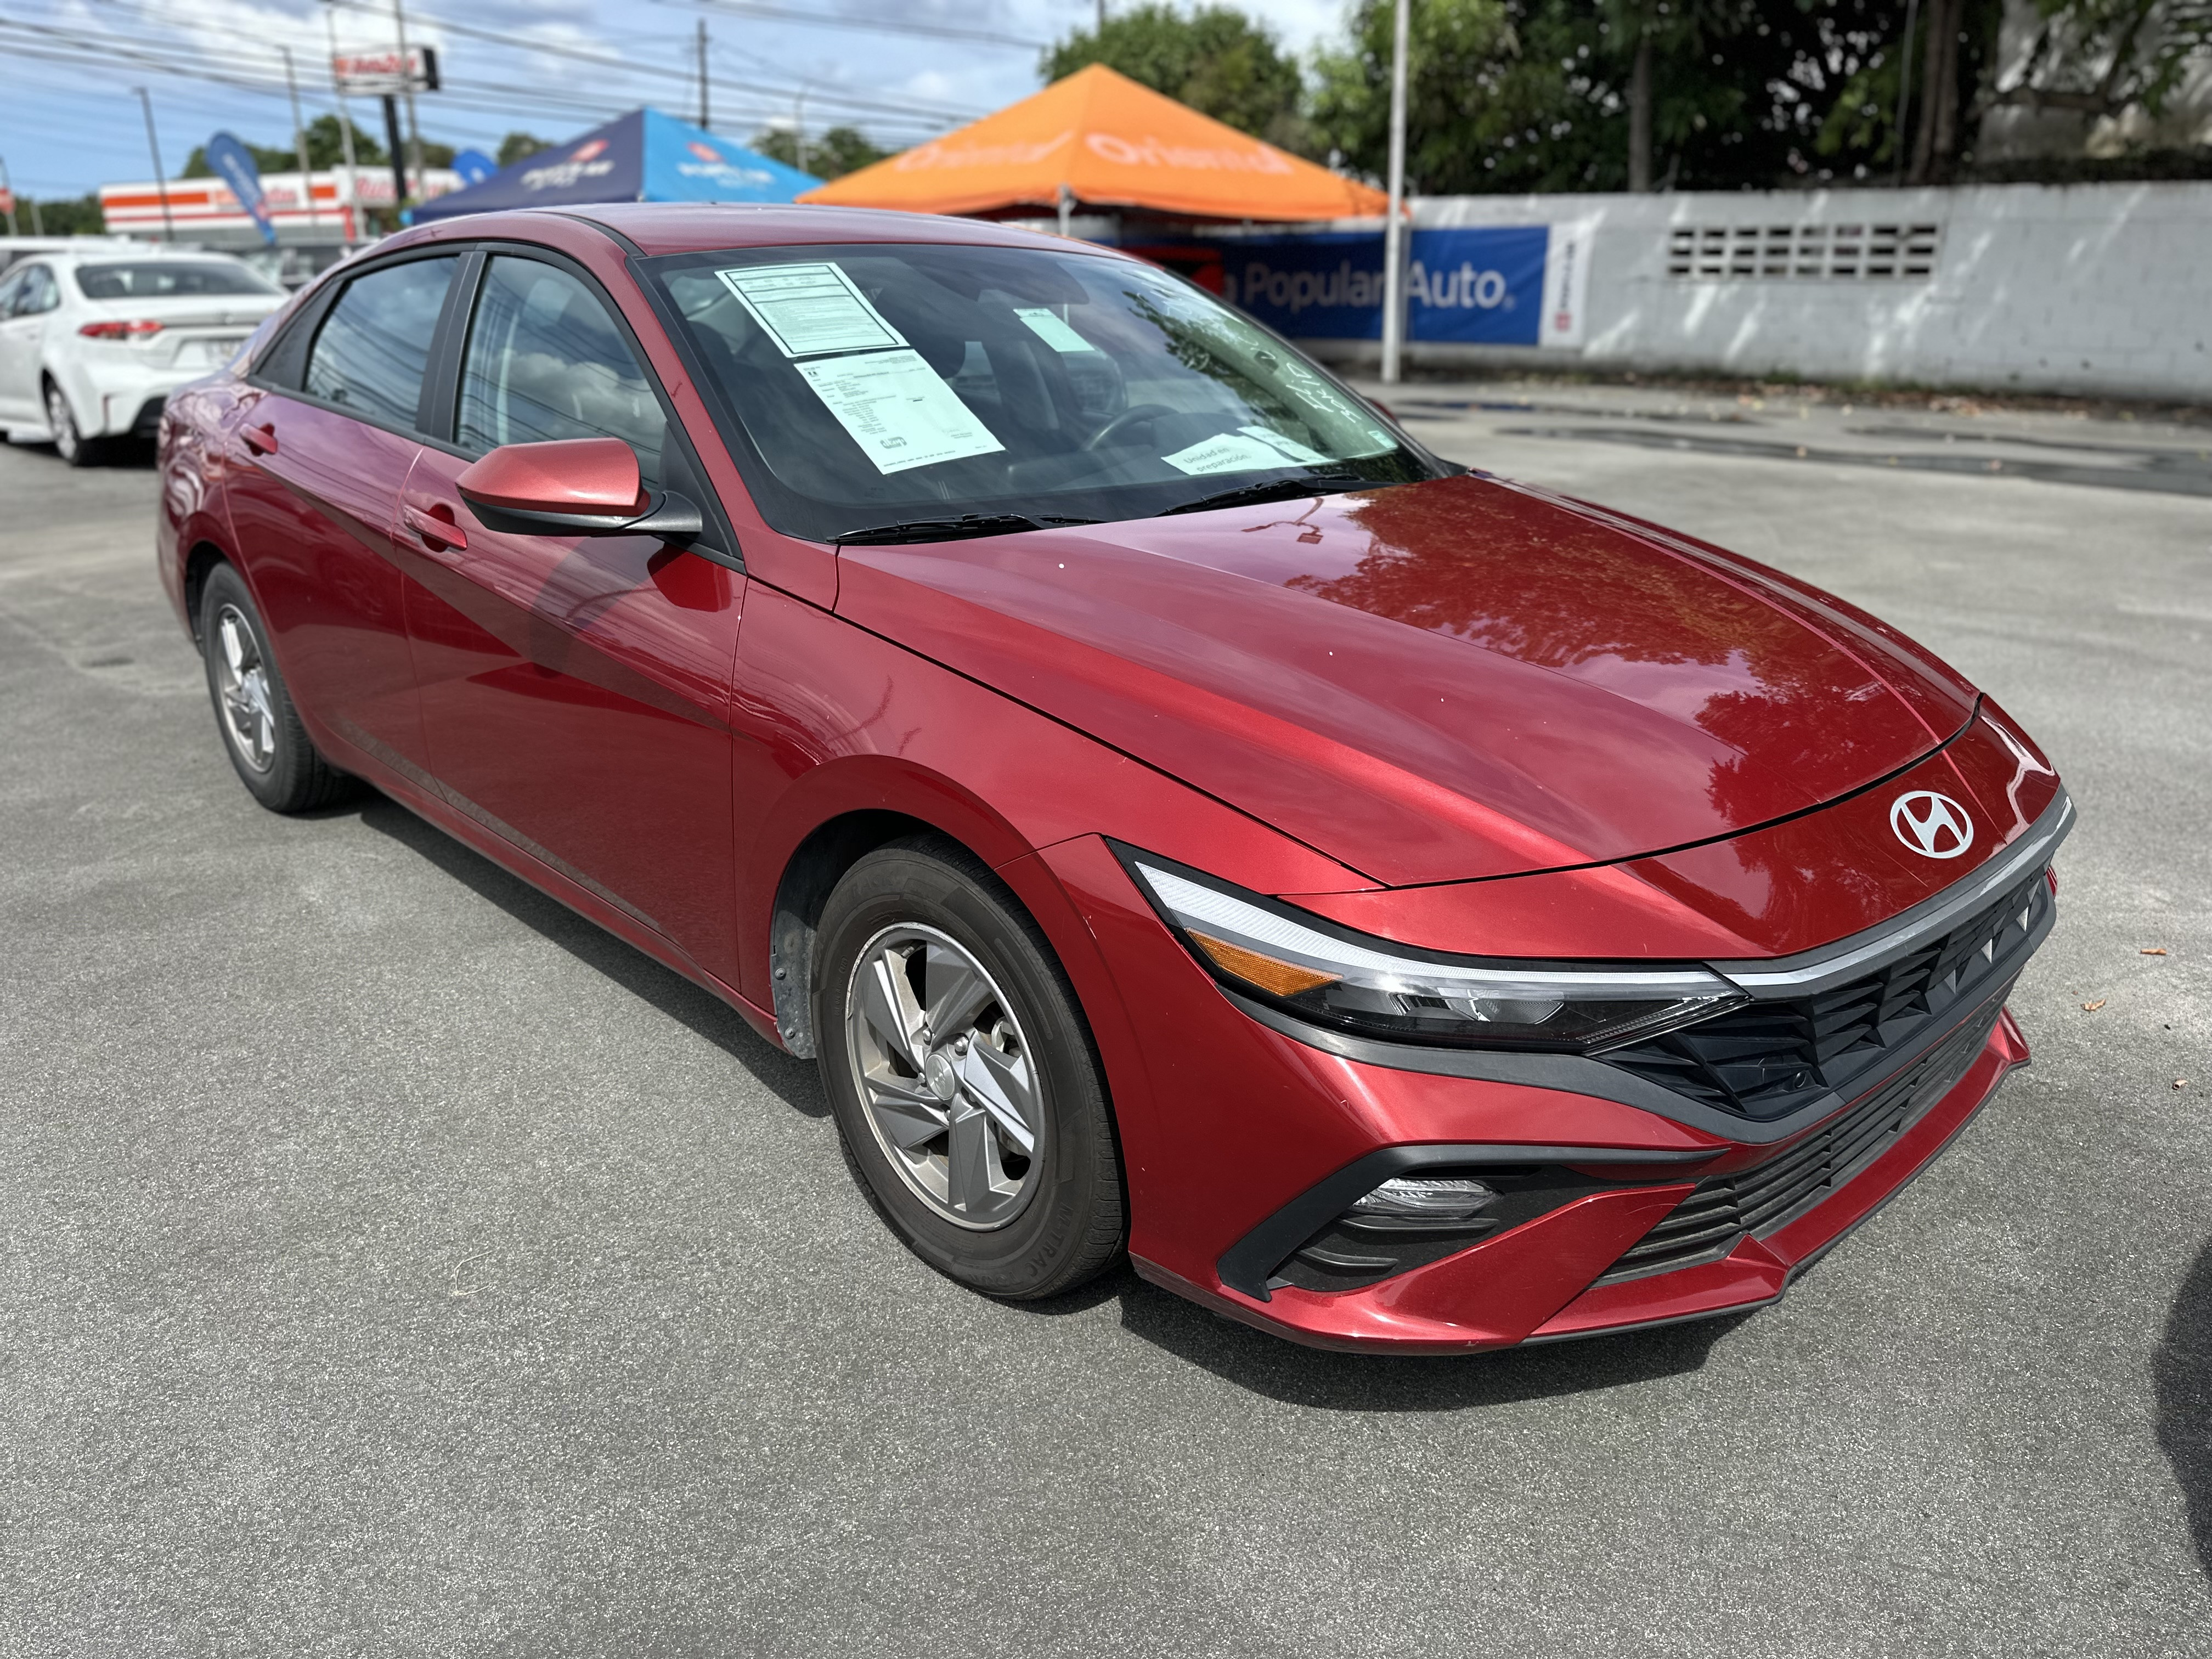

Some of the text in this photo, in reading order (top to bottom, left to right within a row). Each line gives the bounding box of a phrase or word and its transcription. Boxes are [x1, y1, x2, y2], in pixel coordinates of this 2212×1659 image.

[1085, 133, 1295, 176] Oriental
[1245, 258, 1386, 314] Popular
[1183, 447, 1229, 464] Unidad en
[1024, 1201, 1075, 1278] M-TRAC
